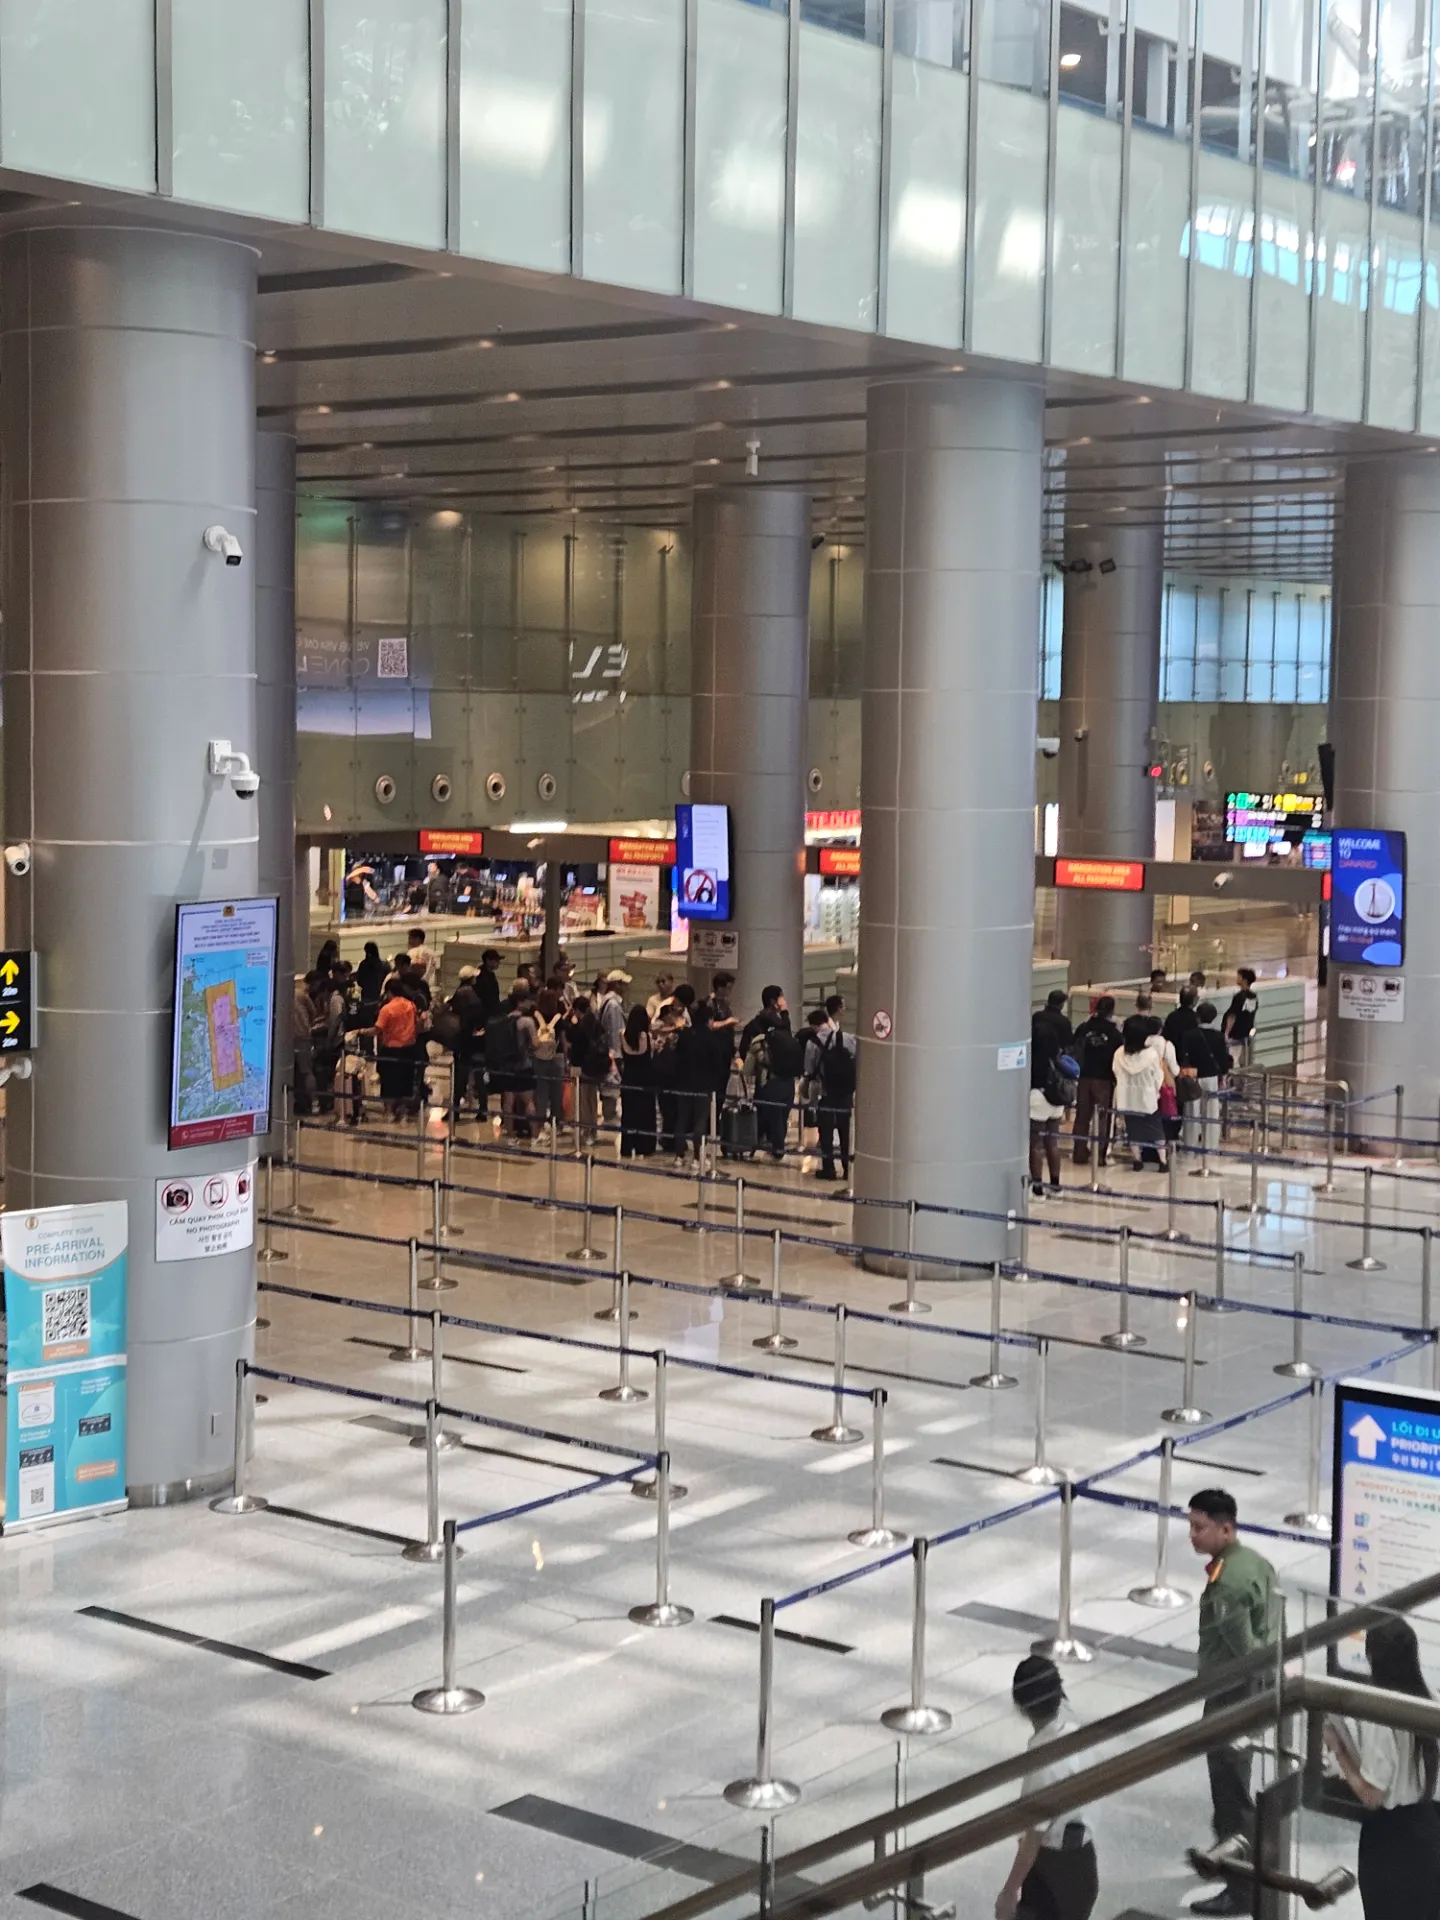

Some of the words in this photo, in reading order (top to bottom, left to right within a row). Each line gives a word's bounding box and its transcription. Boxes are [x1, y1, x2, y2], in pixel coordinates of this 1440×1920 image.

[1338, 837, 1381, 850] WELCOME
[1339, 848, 1352, 859] TO
[187, 1216, 206, 1225] QUAY
[26, 1237, 104, 1256] PRE-ARRIVAL
[25, 1249, 105, 1268] INFORMATION
[1356, 1480, 1394, 1493] PRIORITY
